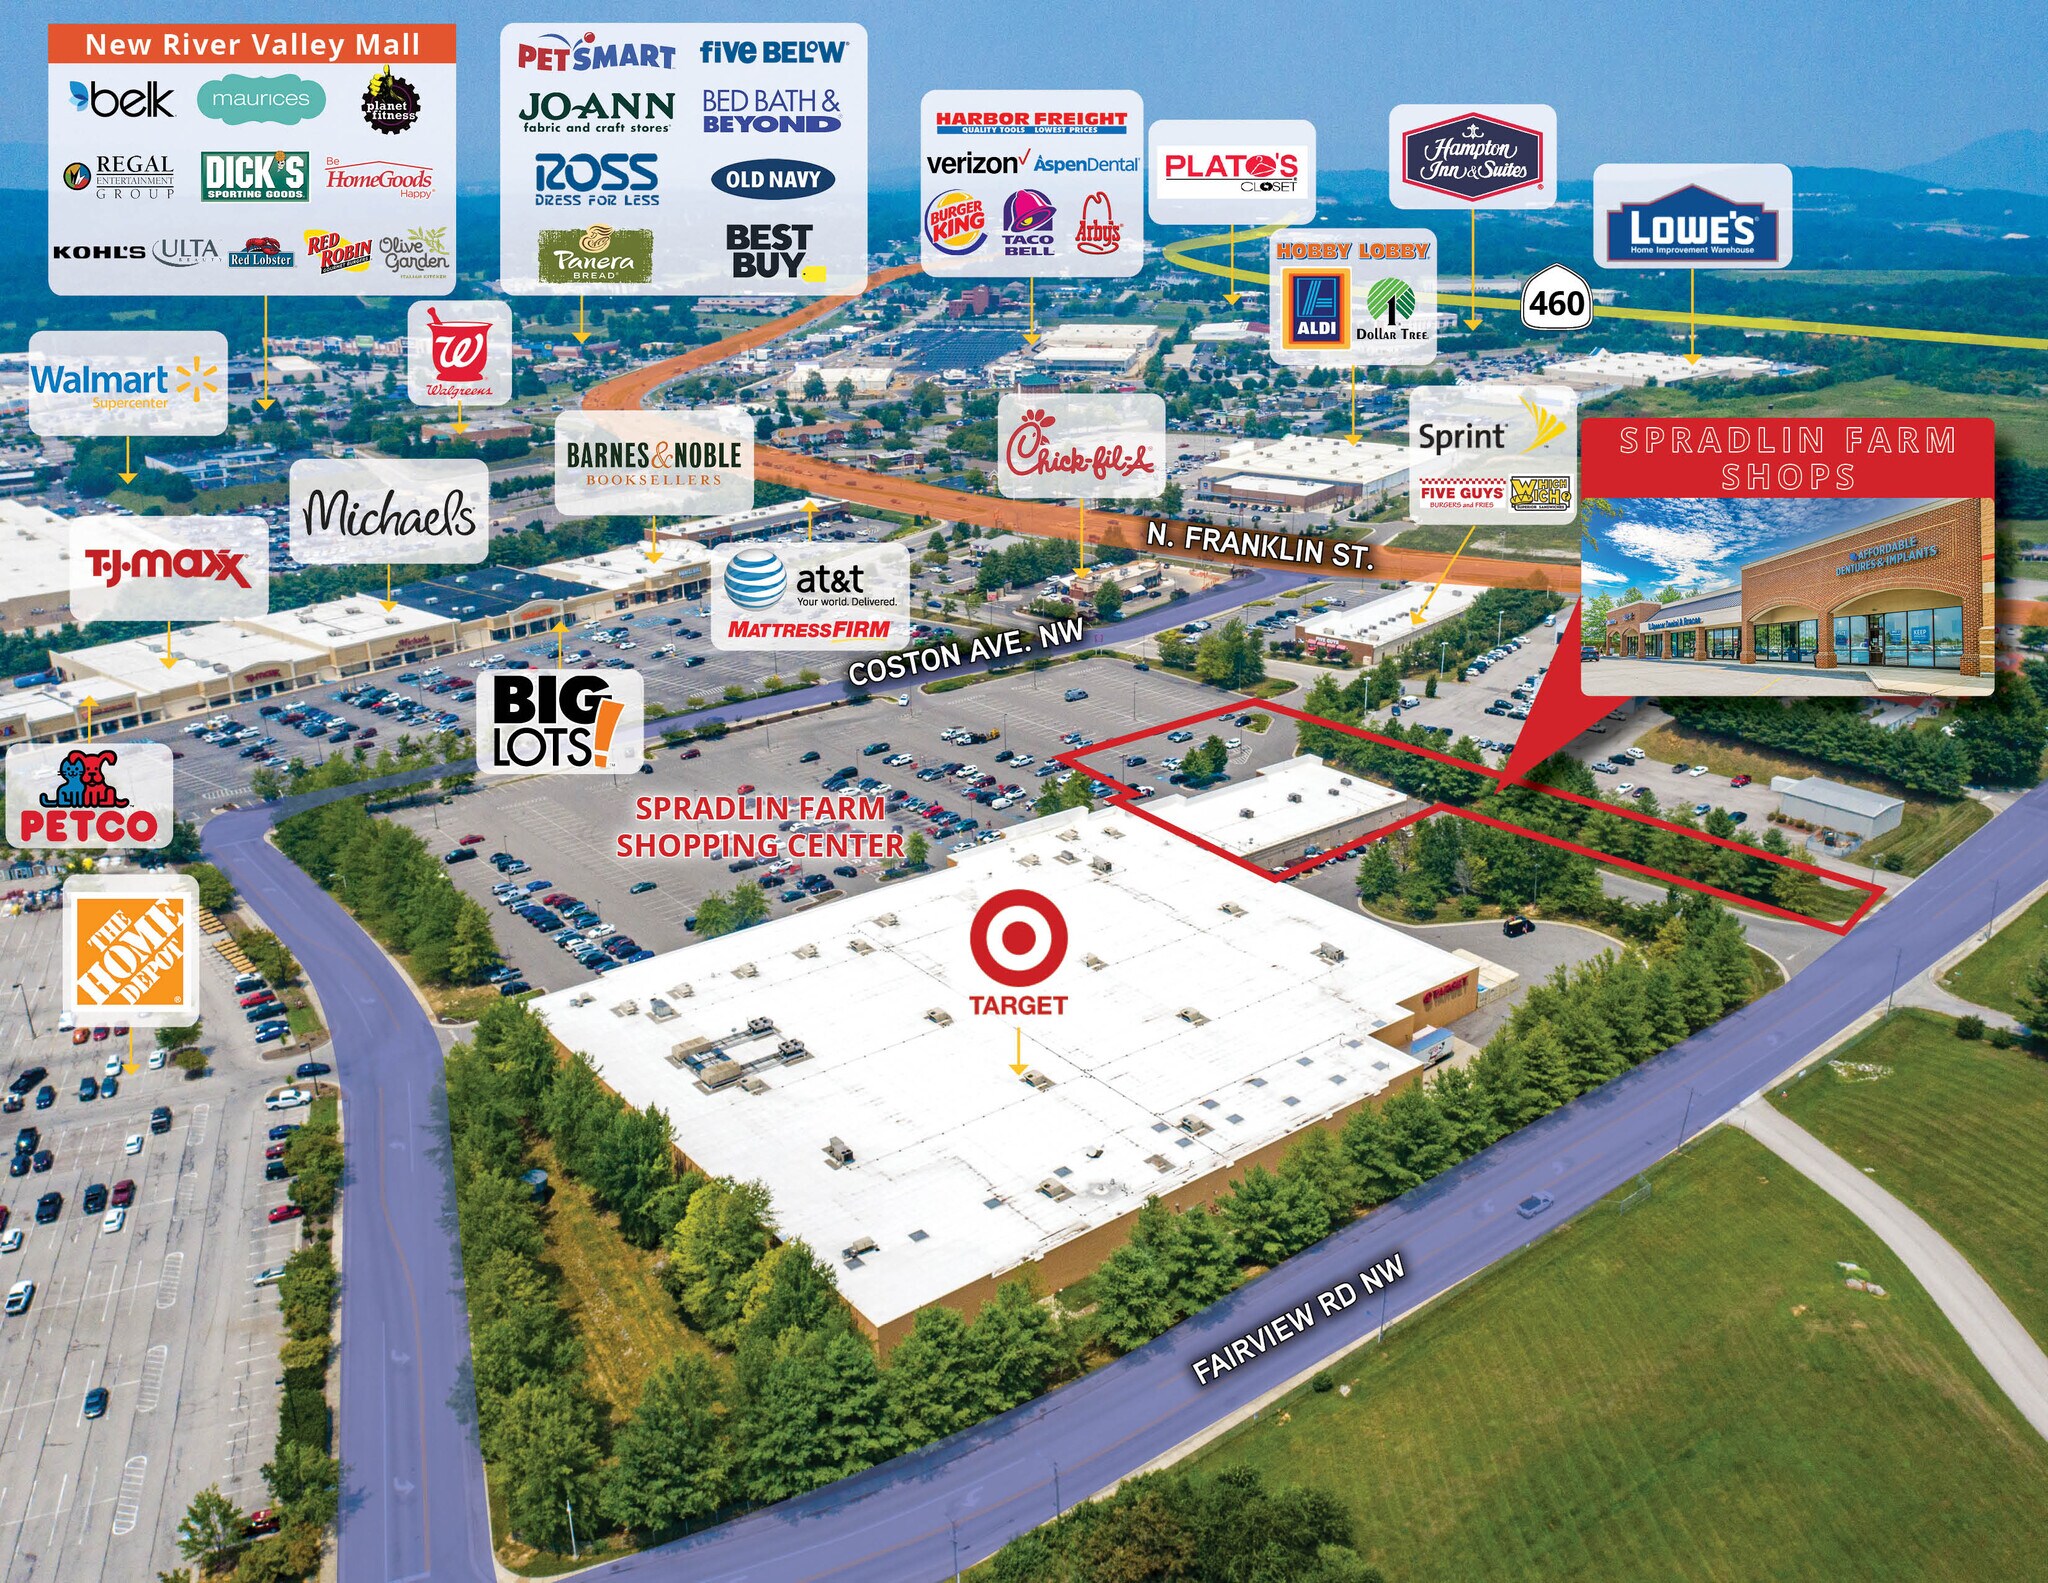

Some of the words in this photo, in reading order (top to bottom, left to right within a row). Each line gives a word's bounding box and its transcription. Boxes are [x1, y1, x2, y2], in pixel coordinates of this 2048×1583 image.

[1858, 536, 1917, 560] AFFORDABLE
[1836, 559, 1876, 576] DENTURES
[1886, 545, 1938, 565] IMPLANTS
[1433, 975, 1468, 997] TARGET
